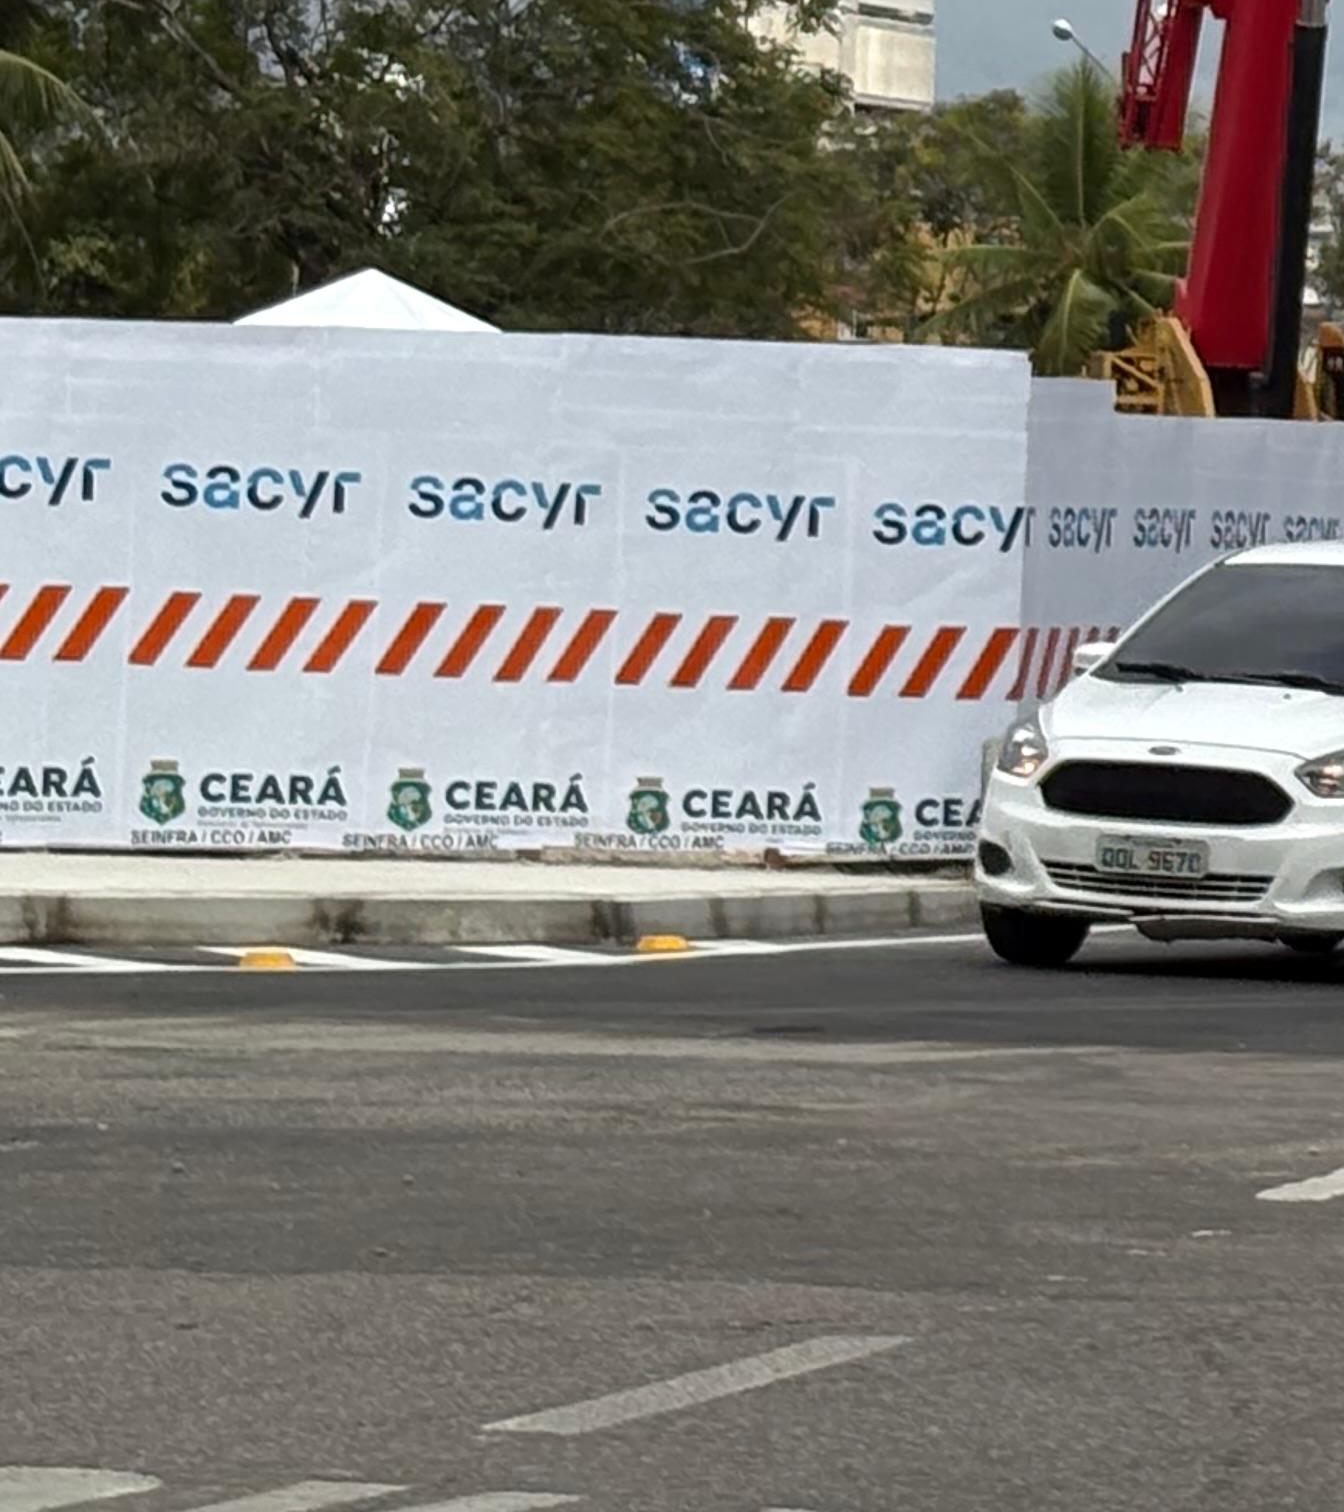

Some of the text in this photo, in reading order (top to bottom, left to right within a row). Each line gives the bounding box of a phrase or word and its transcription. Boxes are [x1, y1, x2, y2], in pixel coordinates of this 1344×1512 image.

[0, 455, 111, 506] cyr
[161, 464, 361, 519] sacyr
[408, 475, 602, 530] sacyr
[646, 488, 835, 542] sacyr
[1048, 506, 1117, 554] sacyr
[1133, 507, 1196, 554] sacyr
[0, 756, 101, 799] ARÁ
[199, 765, 347, 807] CEARÁ
[444, 773, 588, 814] CEARÁ
[682, 782, 822, 823] CEARÁ
[915, 798, 982, 827] CEA
